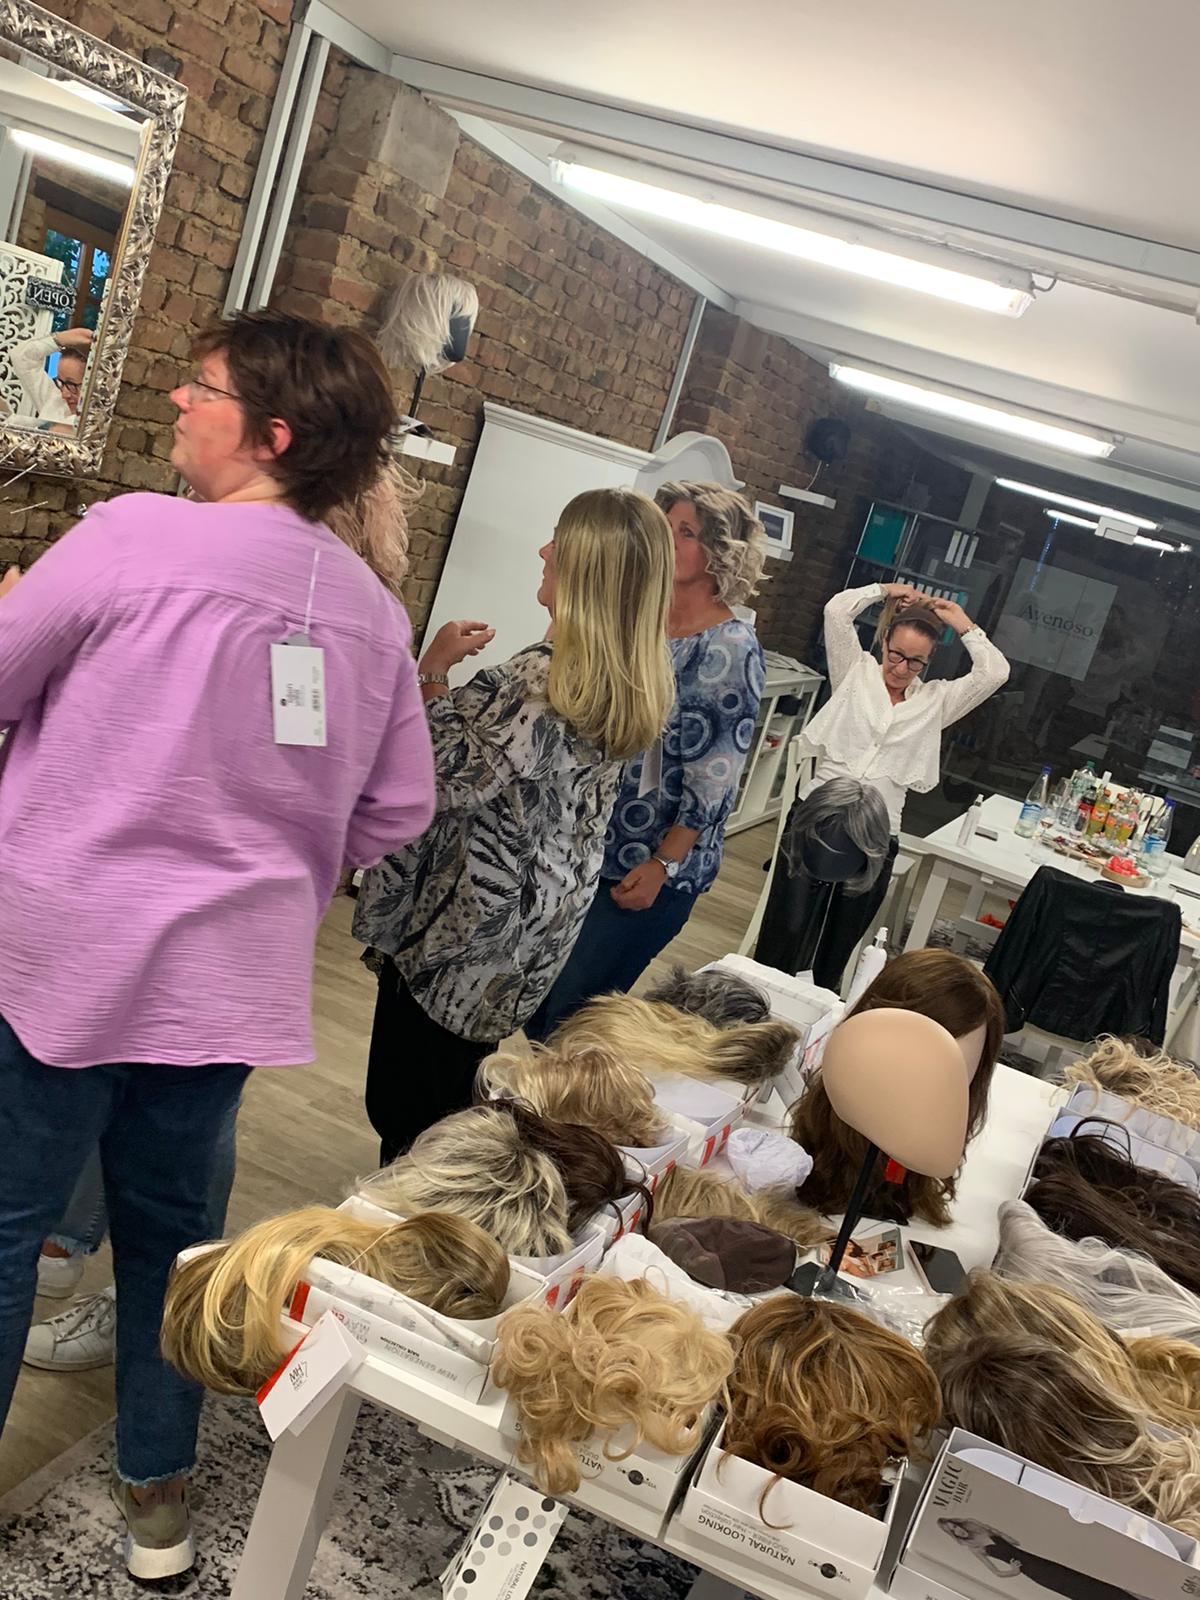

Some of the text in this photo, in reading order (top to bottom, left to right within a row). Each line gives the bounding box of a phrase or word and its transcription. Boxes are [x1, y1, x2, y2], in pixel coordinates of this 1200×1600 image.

[933, 1461, 963, 1510] MAGIC
[698, 1514, 745, 1542] LOOKING
[748, 1537, 796, 1566] NATURAL
